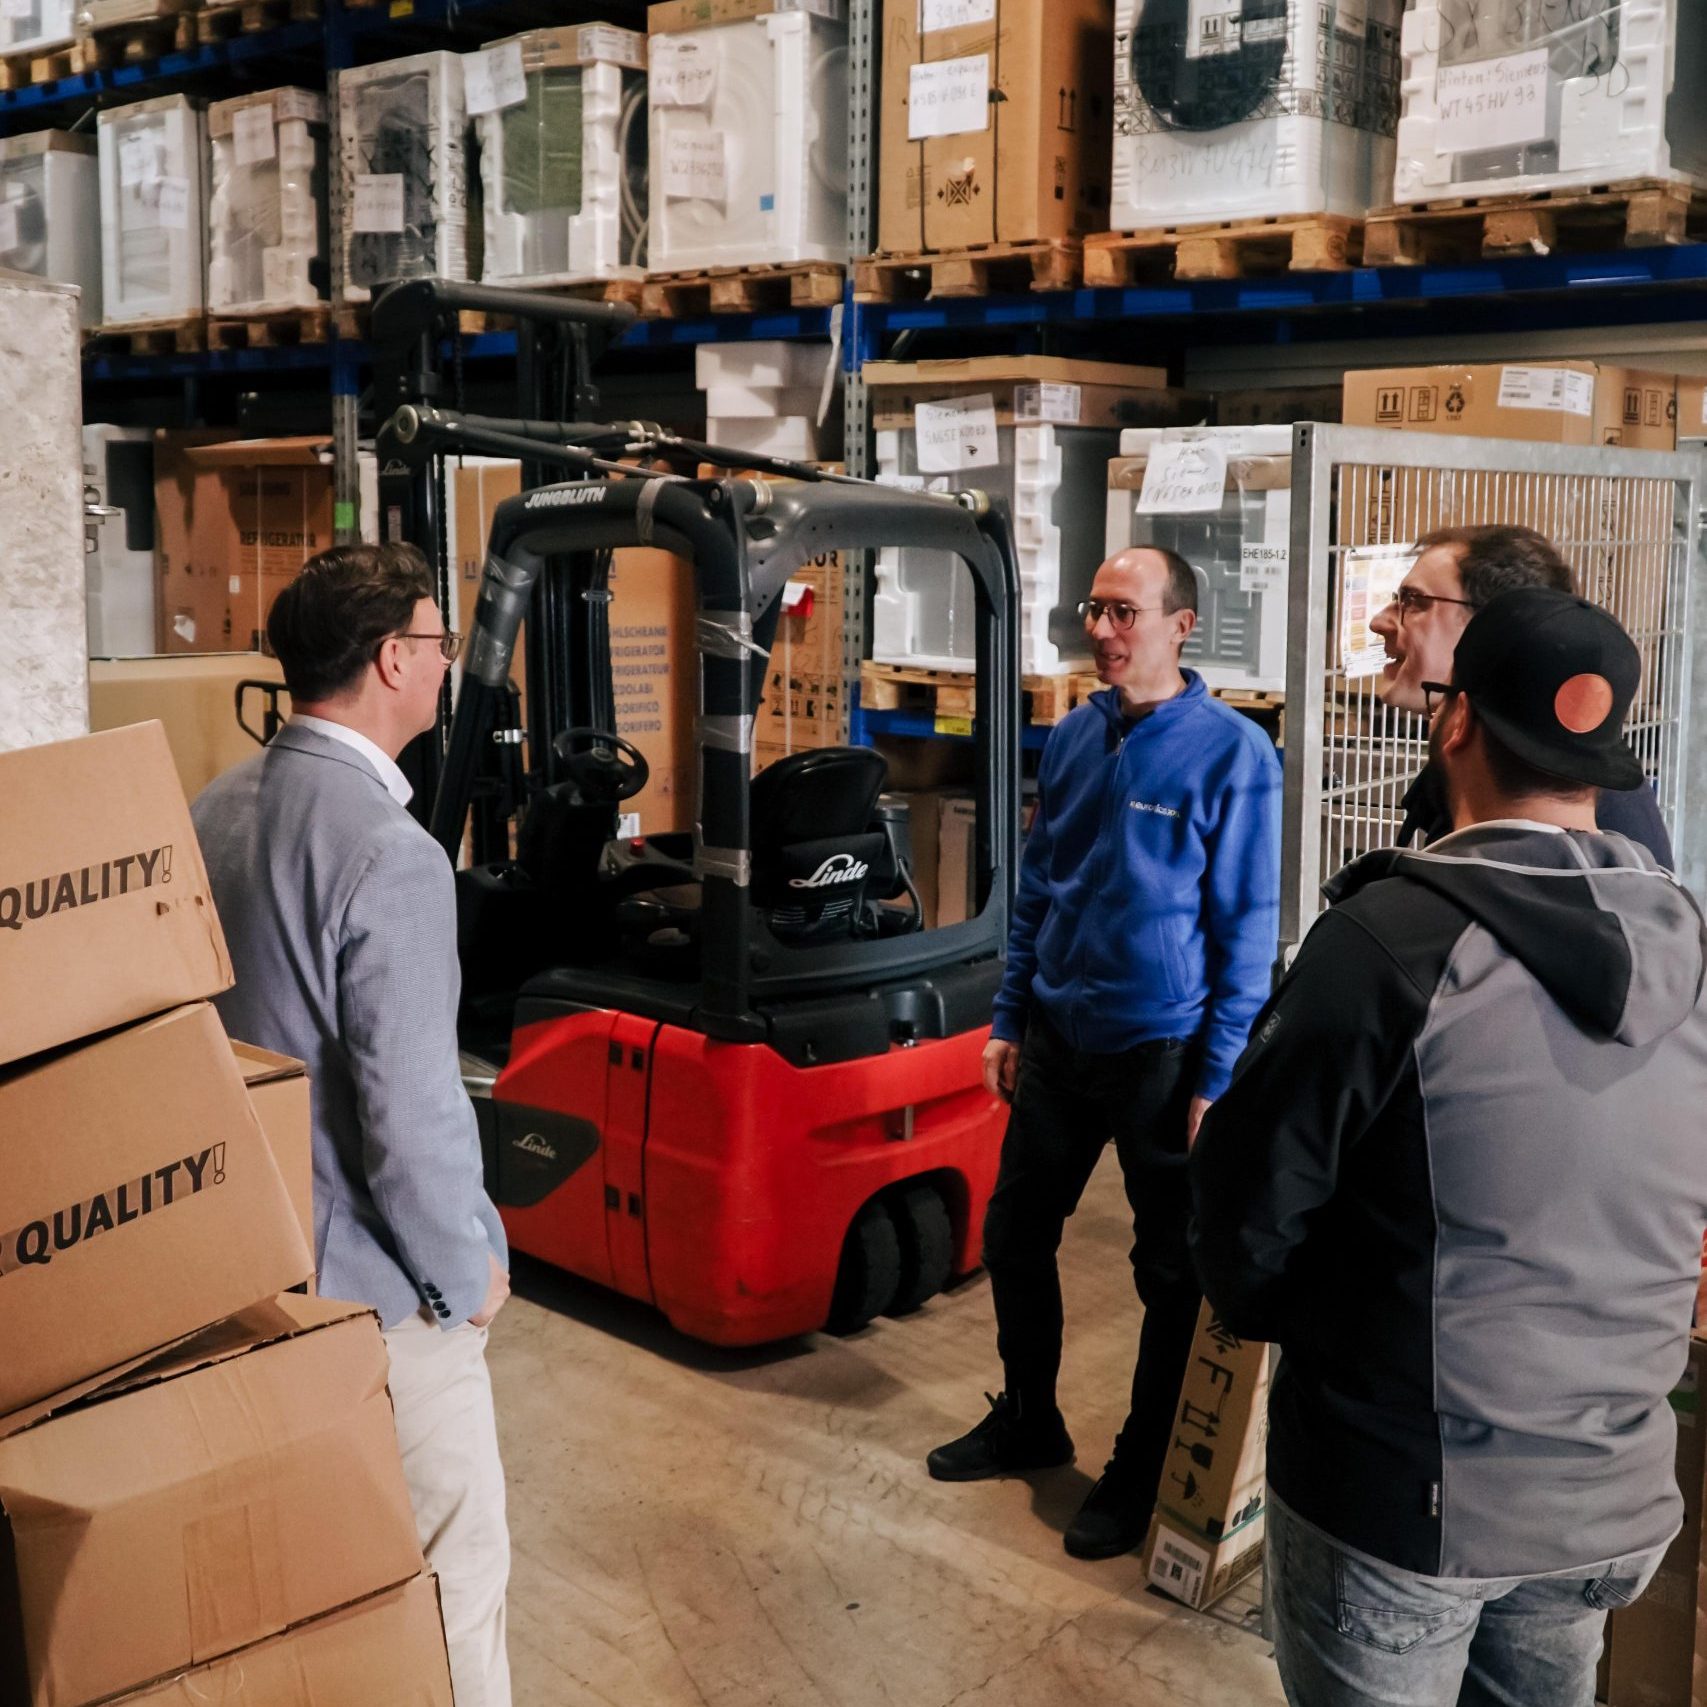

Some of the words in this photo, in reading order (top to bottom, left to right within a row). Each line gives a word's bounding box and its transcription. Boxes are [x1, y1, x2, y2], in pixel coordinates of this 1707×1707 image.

[525, 487, 607, 508] JUNGBLUTH
[788, 853, 869, 888] Linde
[512, 1133, 557, 1159] Linde
[16, 1141, 226, 1265] QUALITY!
